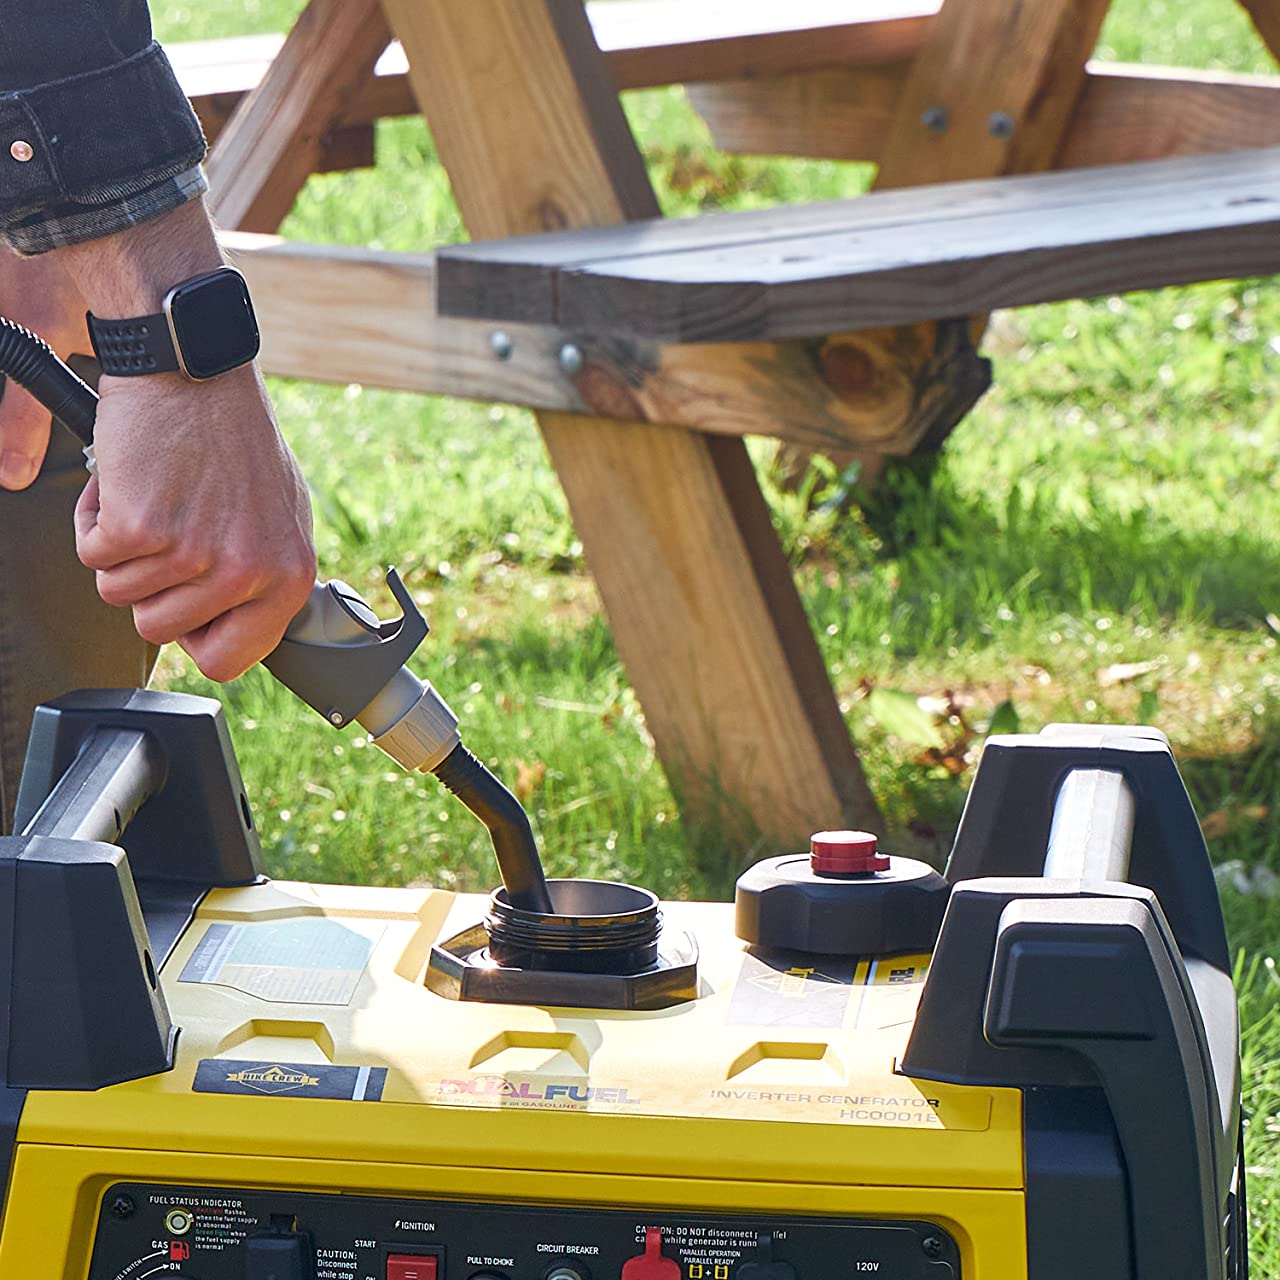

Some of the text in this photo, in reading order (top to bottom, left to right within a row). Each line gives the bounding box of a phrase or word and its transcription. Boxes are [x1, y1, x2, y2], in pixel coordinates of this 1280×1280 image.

[439, 1079, 641, 1104] DUAL FUEL
[711, 1089, 940, 1108] INVERTER GENERATOR
[521, 1101, 578, 1110] GASOLINE
[149, 1195, 242, 1208] FUEL STATUS INDICATOR
[224, 1215, 237, 1223] fuel
[401, 1221, 435, 1232] IGNITION
[676, 1227, 688, 1236] DO
[689, 1227, 706, 1237] NOT
[707, 1228, 754, 1238] disconnect
[151, 1240, 169, 1249] GAS
[354, 1239, 376, 1248] START
[665, 1236, 686, 1245] while
[688, 1237, 728, 1247] generator
[729, 1239, 738, 1247] is
[316, 1249, 358, 1260] CAUTION:
[536, 1243, 599, 1255] CIRCUIT BREAKER
[679, 1248, 741, 1258] PARALLEL OPERATION
[123, 1258, 143, 1276] SWITCH
[169, 1262, 181, 1270] ON
[317, 1260, 358, 1270] Disconnect
[466, 1256, 514, 1267] PULL TO CHOKE
[683, 1257, 735, 1266] PARALLEL READY
[855, 1261, 880, 1272] 120V
[316, 1270, 337, 1280] while
